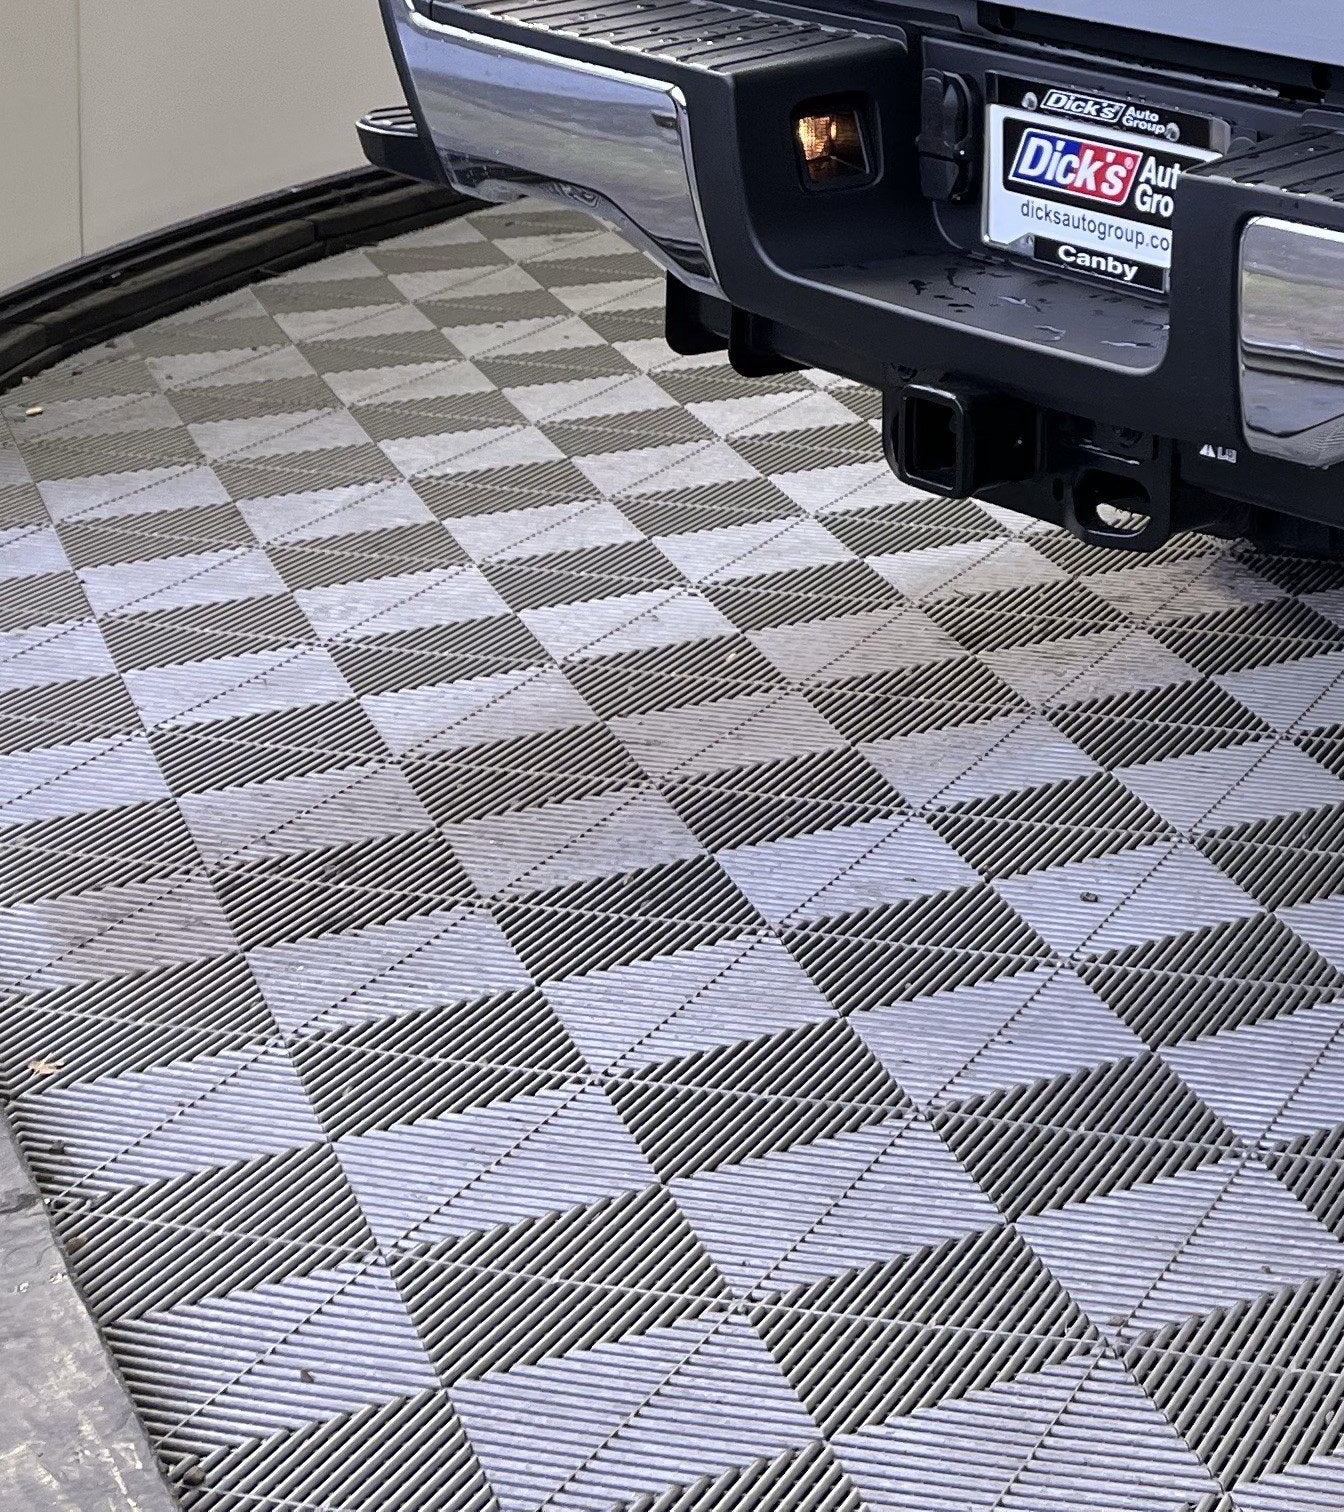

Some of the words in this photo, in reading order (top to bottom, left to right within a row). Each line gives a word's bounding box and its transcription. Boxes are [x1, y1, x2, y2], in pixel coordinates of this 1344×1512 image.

[1046, 91, 1116, 120] Dick's
[1125, 106, 1159, 122] Auto
[1122, 116, 1166, 135] Group
[1017, 136, 1128, 197] Dick's
[1139, 156, 1181, 190] Aut
[1134, 184, 1175, 218] Gro
[1020, 199, 1170, 252] dicksautogroup.co
[1057, 244, 1139, 281] Canby
